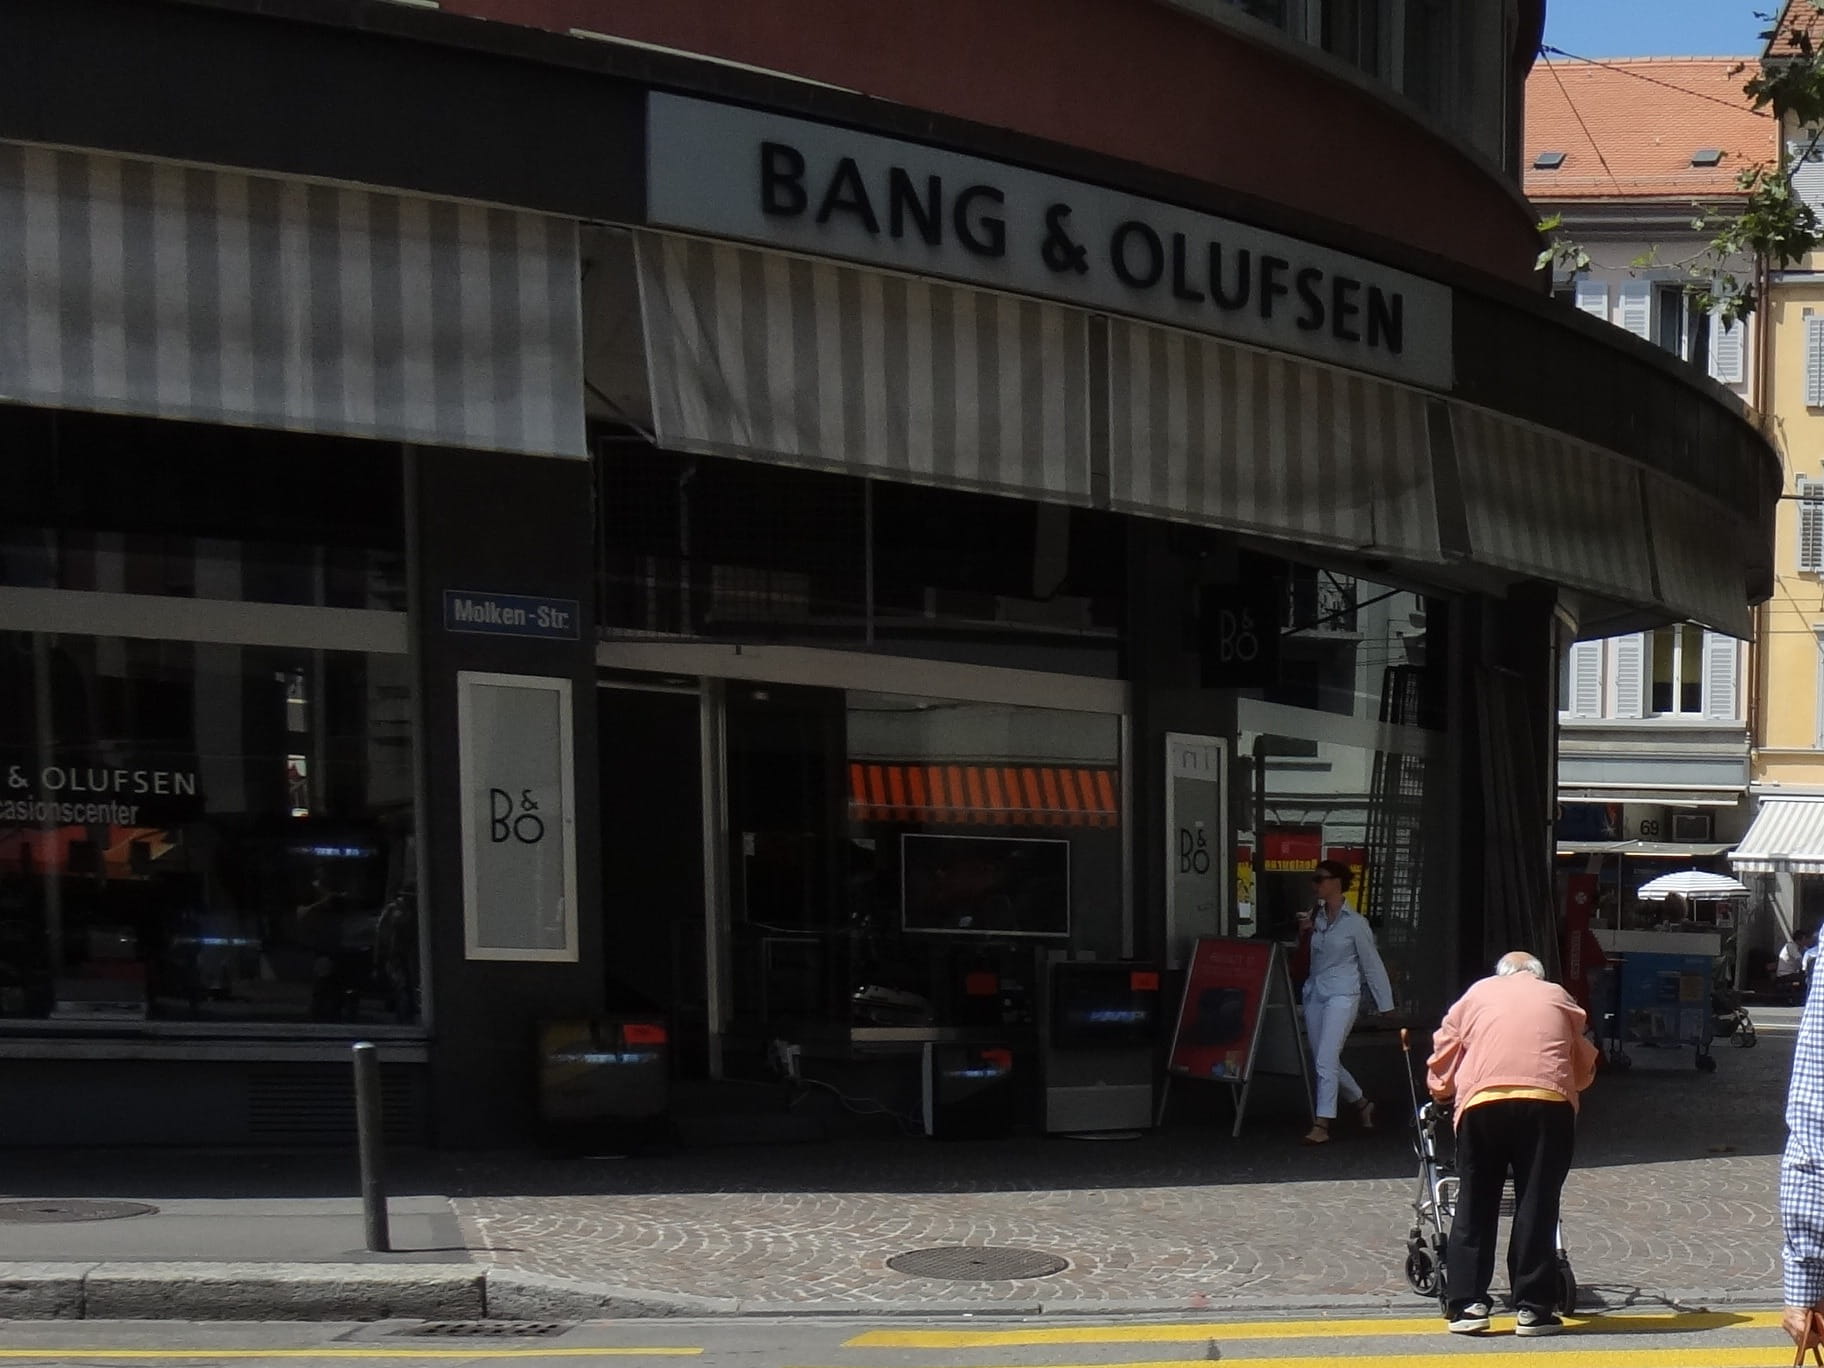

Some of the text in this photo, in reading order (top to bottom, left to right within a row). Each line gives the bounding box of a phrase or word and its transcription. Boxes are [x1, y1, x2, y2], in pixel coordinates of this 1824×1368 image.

[759, 139, 1404, 356] BANG & OLUFSEN
[8, 765, 196, 796] & OLUFSEN
[1639, 819, 1660, 837] 69
